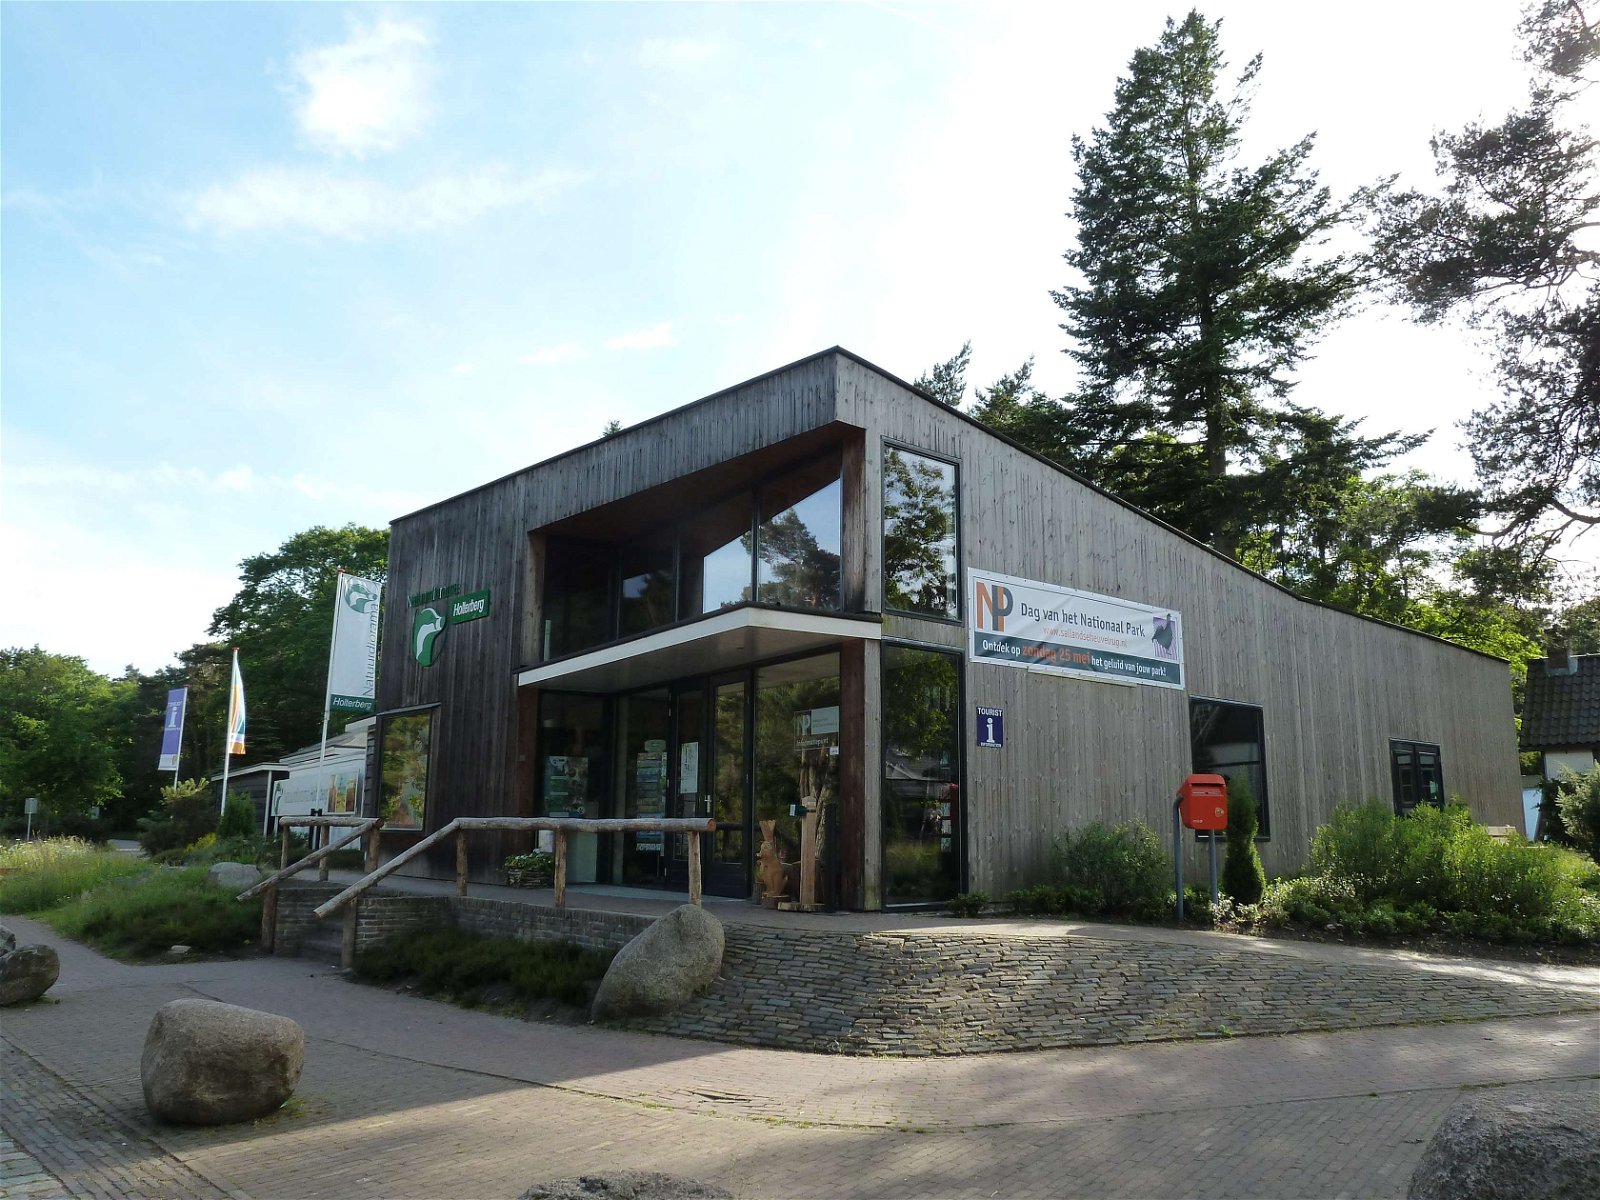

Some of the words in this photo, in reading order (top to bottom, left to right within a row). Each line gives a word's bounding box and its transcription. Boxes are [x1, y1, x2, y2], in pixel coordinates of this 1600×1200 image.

[453, 599, 485, 617] Holterberg
[1021, 602, 1040, 622] Dag
[1043, 609, 1059, 622] van
[1061, 609, 1078, 625] het
[1080, 613, 1124, 634] Nationaal
[1126, 622, 1146, 637] Park
[363, 603, 378, 697] Natuurdiorama
[982, 639, 1010, 654] Ontdek
[1011, 646, 1021, 657] op
[1022, 645, 1057, 663] zondag
[1059, 648, 1070, 661] 25
[1072, 652, 1090, 664] mei
[1091, 655, 1103, 667] het
[1104, 658, 1124, 670] geluid
[1124, 662, 1136, 672] van
[1136, 663, 1151, 675] jouw
[1151, 666, 1167, 677] park!
[332, 697, 372, 710] Holterberg
[977, 707, 1003, 717] TOURIST
